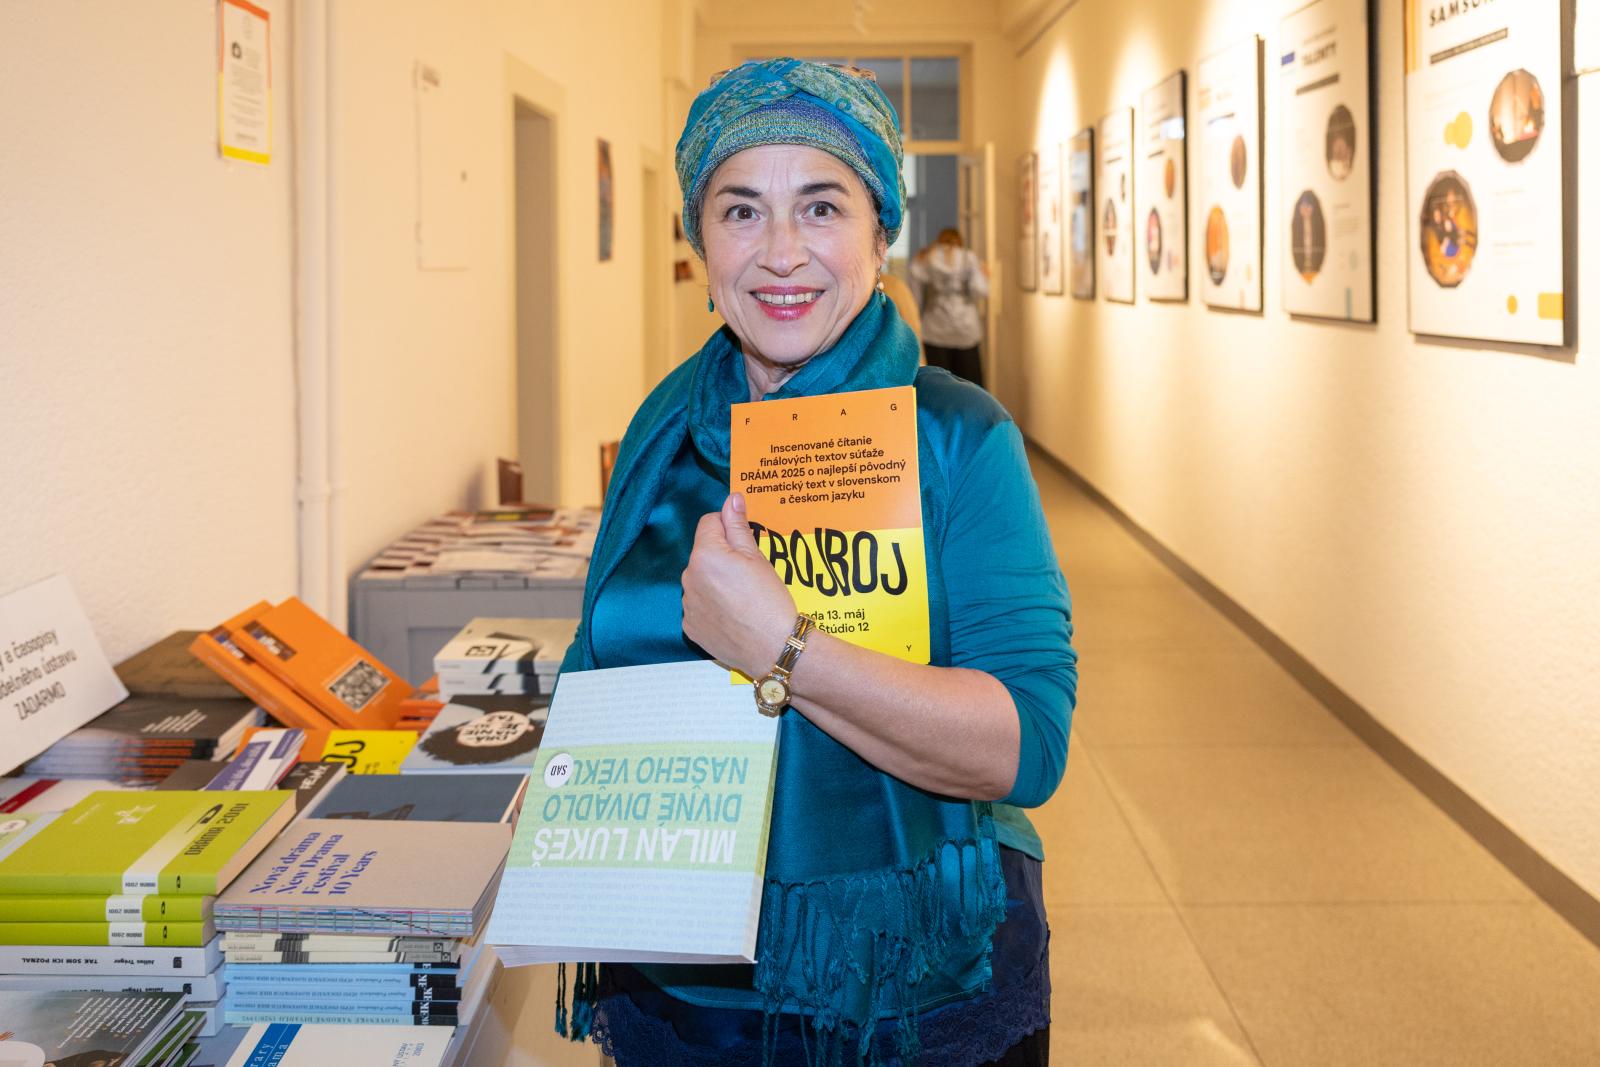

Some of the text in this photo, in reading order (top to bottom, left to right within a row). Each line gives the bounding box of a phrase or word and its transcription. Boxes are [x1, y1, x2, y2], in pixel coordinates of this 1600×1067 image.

[770, 436, 872, 453] Inscenované čítanie
[760, 448, 884, 467] finálových textov súťaže
[740, 468, 779, 481] DRÁMA
[781, 467, 805, 478] 2025
[817, 462, 857, 476] najlepší
[860, 459, 906, 474] pôvodný
[746, 479, 804, 494] dramatický
[806, 478, 826, 488] text
[837, 473, 900, 486] slovenskom
[780, 490, 865, 504] a českom jazyku
[827, 610, 842, 620] 13.
[844, 608, 866, 620] máj
[819, 622, 869, 634] Štúdio 12
[14, 681, 66, 721] ZADARMO
[549, 764, 568, 777] SAD
[636, 756, 749, 790] NAŠEHO
[216, 803, 250, 825] 2001
[542, 792, 743, 828] DIVNÉ DIVADLO
[531, 827, 737, 868] MILAN LUKEŠ
[248, 832, 321, 894] Nová dráma
[274, 834, 344, 895] New Drama
[327, 851, 378, 896] 10 Years
[302, 854, 351, 895] Festival
